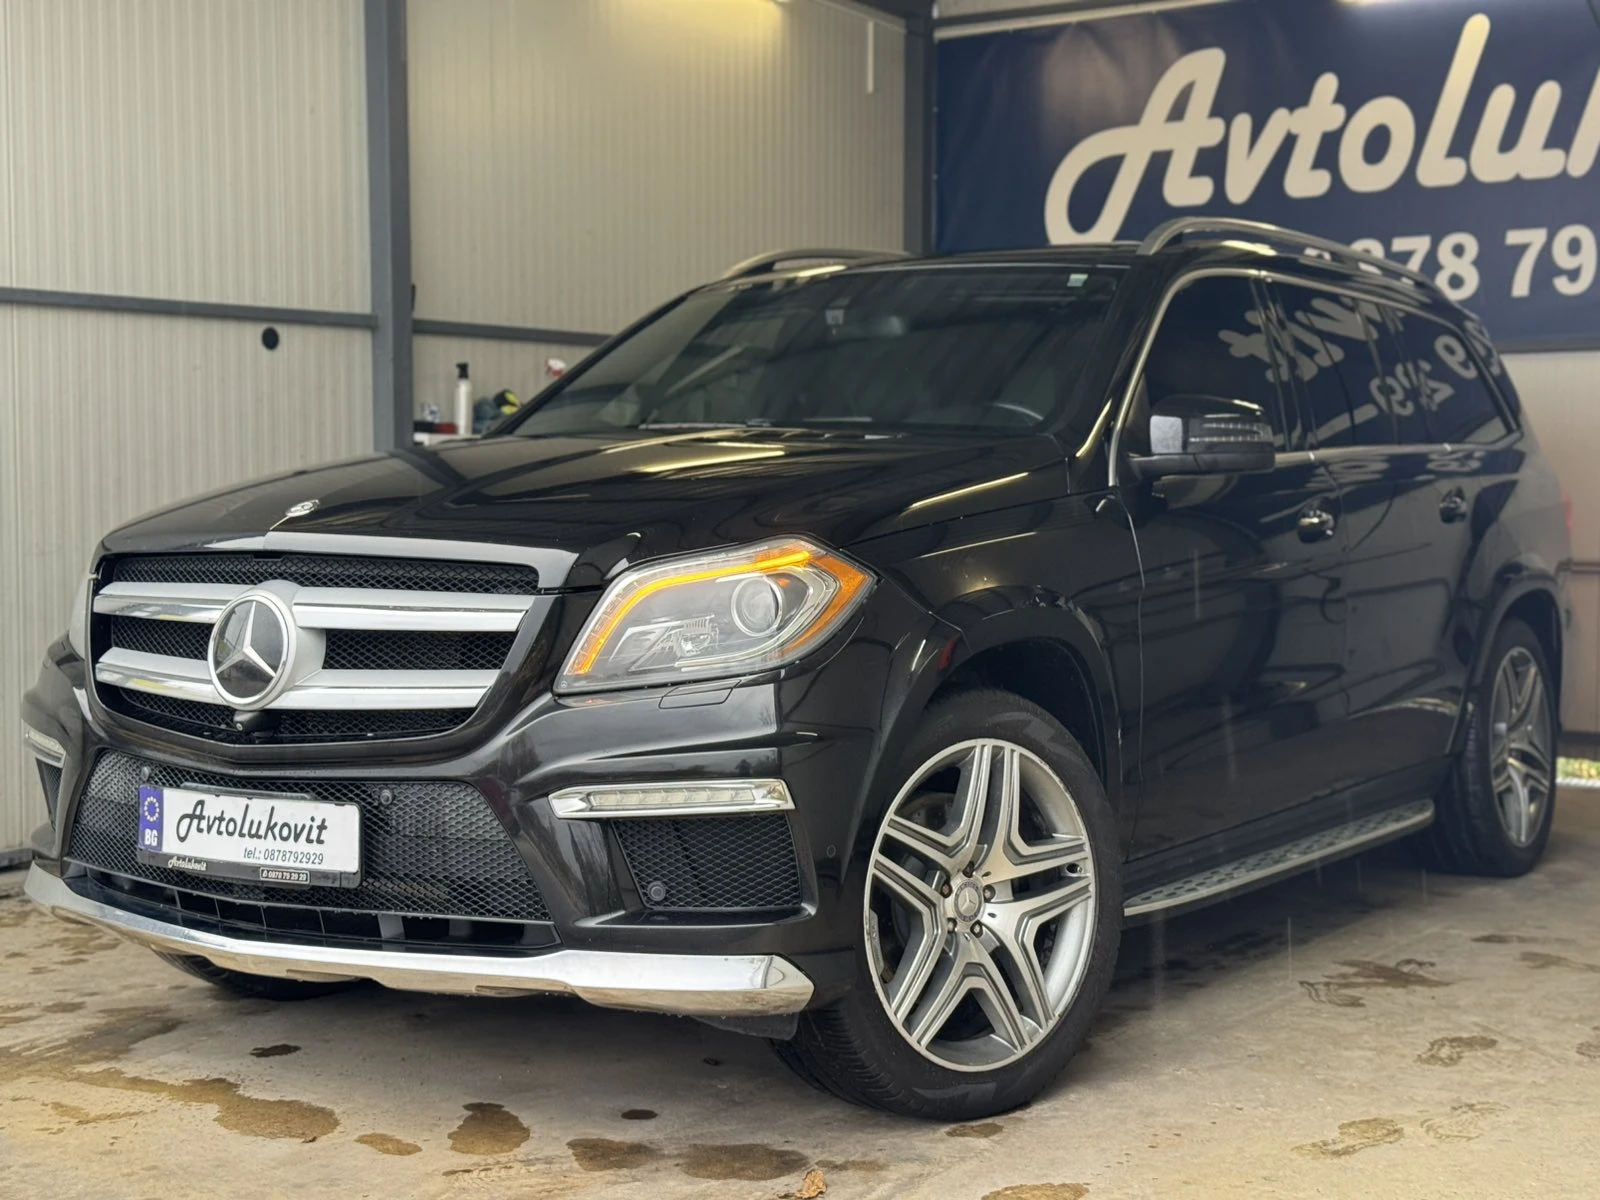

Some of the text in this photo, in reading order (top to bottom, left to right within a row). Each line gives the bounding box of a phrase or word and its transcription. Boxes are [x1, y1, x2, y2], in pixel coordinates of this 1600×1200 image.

[1505, 224, 1598, 298] 79
[144, 828, 158, 846] BG
[176, 799, 328, 845] Avtolukovit
[243, 846, 324, 865] tel.: 0878792929
